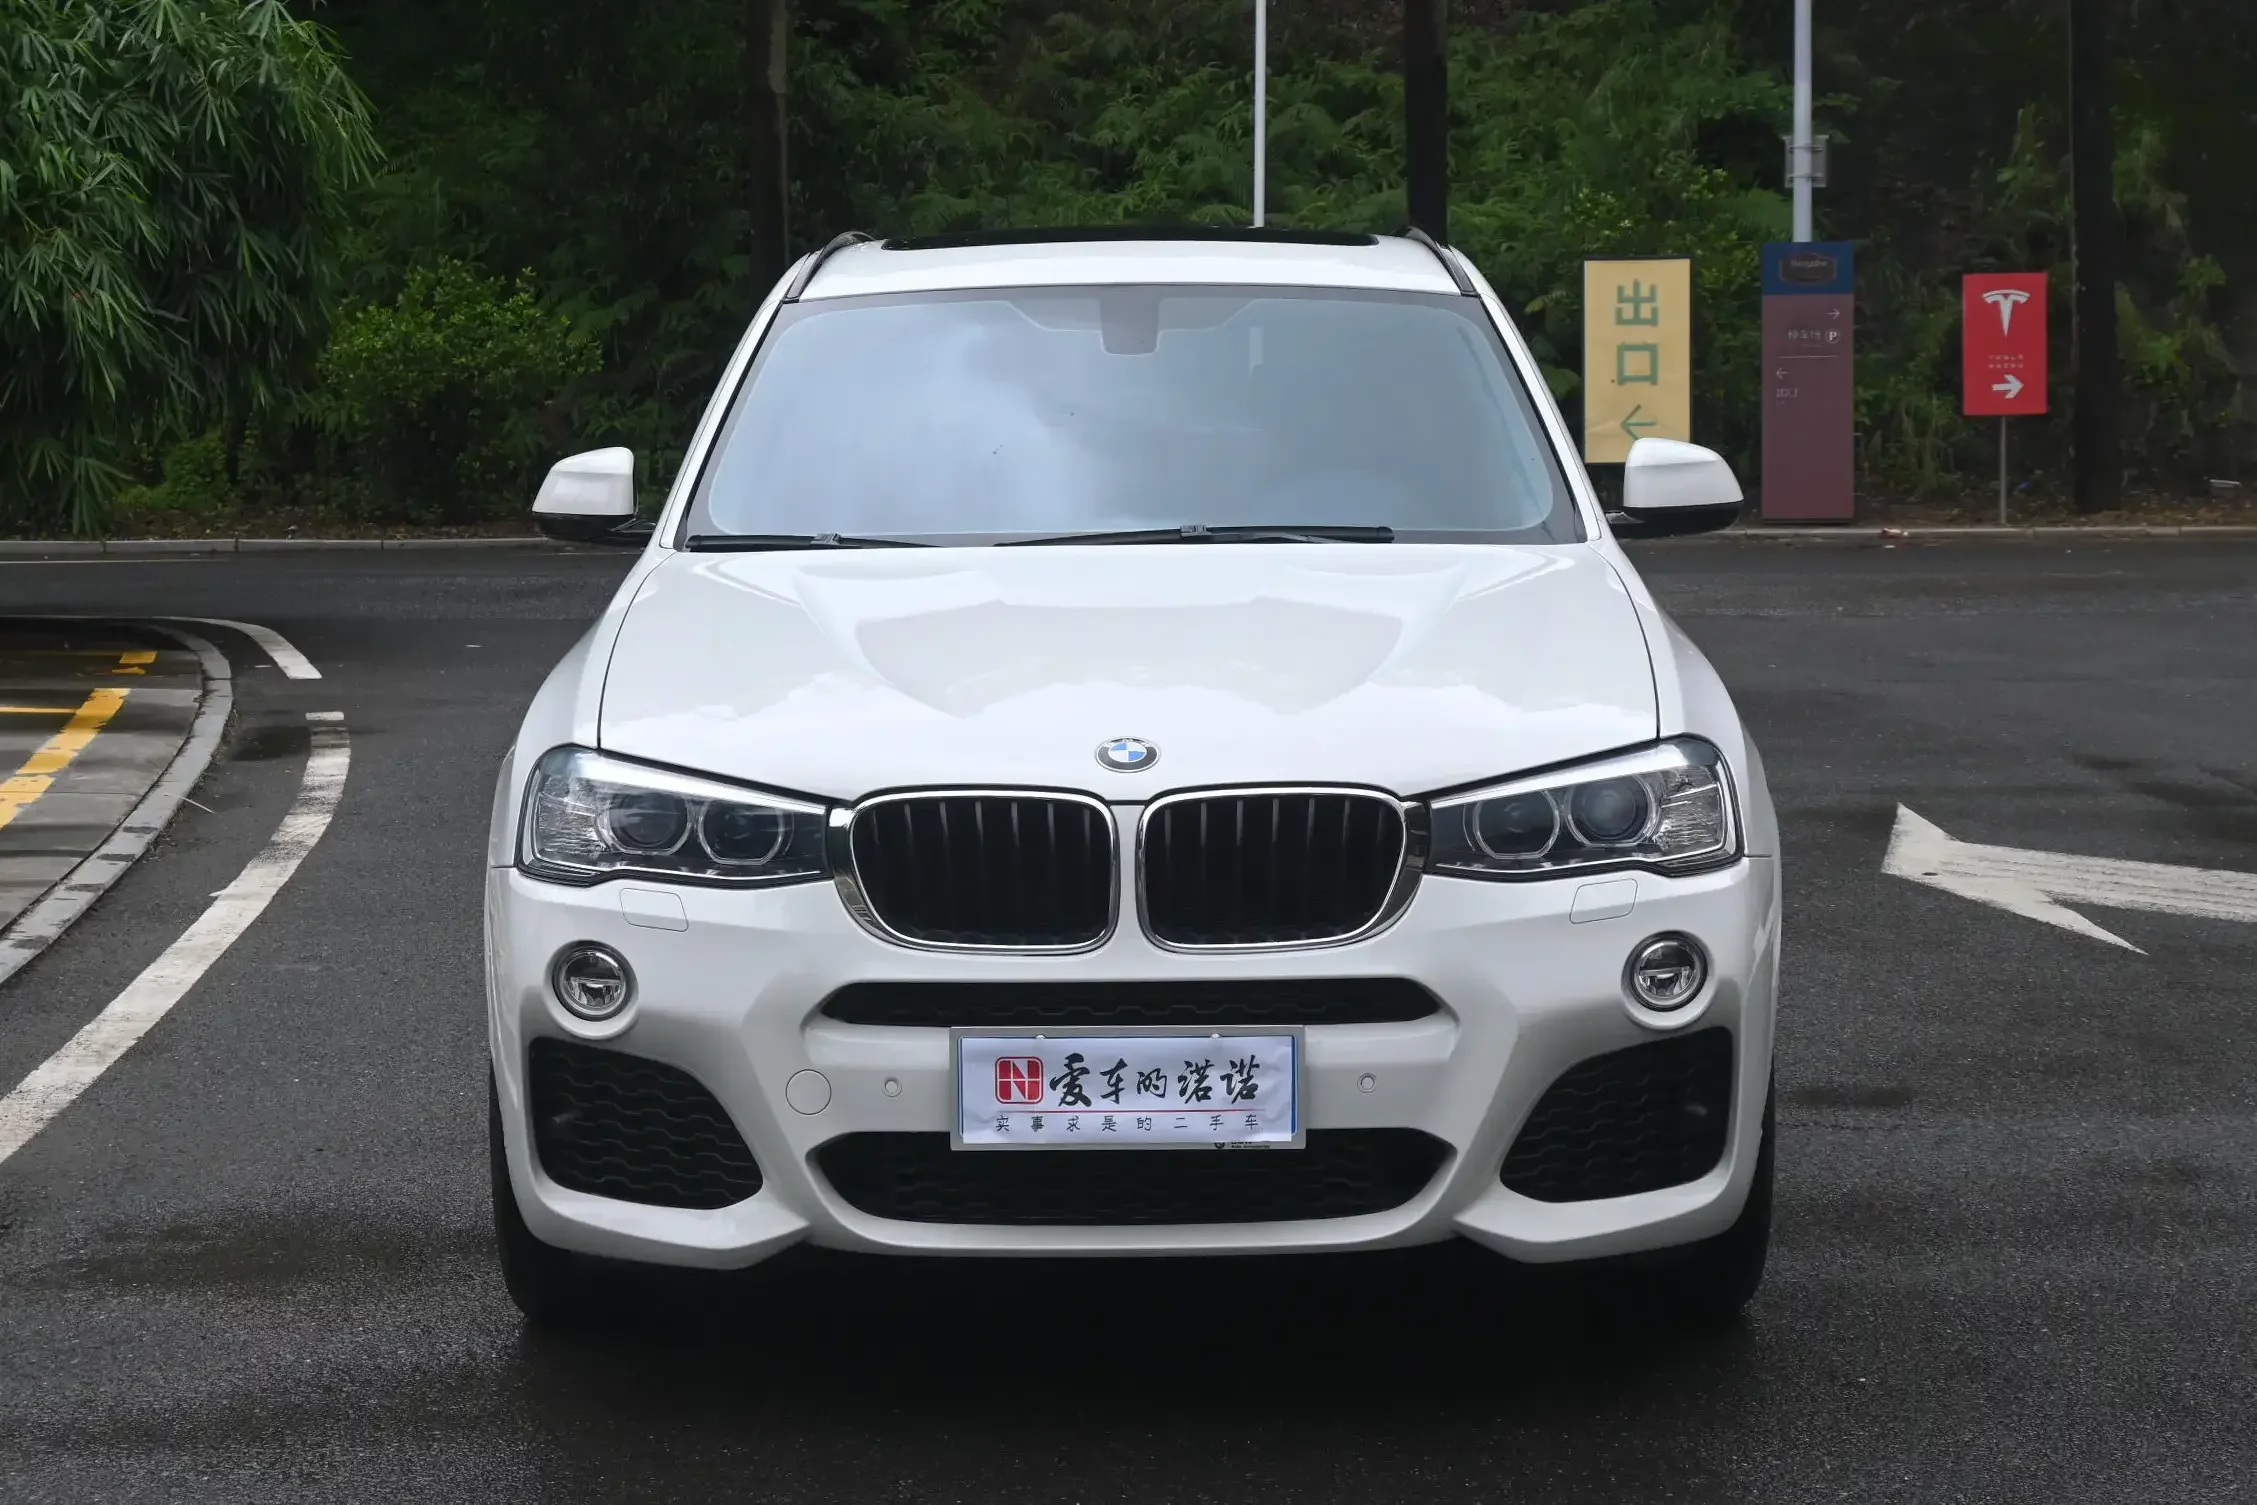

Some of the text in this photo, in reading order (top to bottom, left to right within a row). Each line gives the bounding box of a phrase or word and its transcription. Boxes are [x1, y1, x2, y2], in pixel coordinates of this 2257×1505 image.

[1614, 278, 1659, 386] 出口
[1049, 1052, 1261, 1107] 爱车的诺诺
[995, 1114, 1260, 1132] 实事求是的二手车
